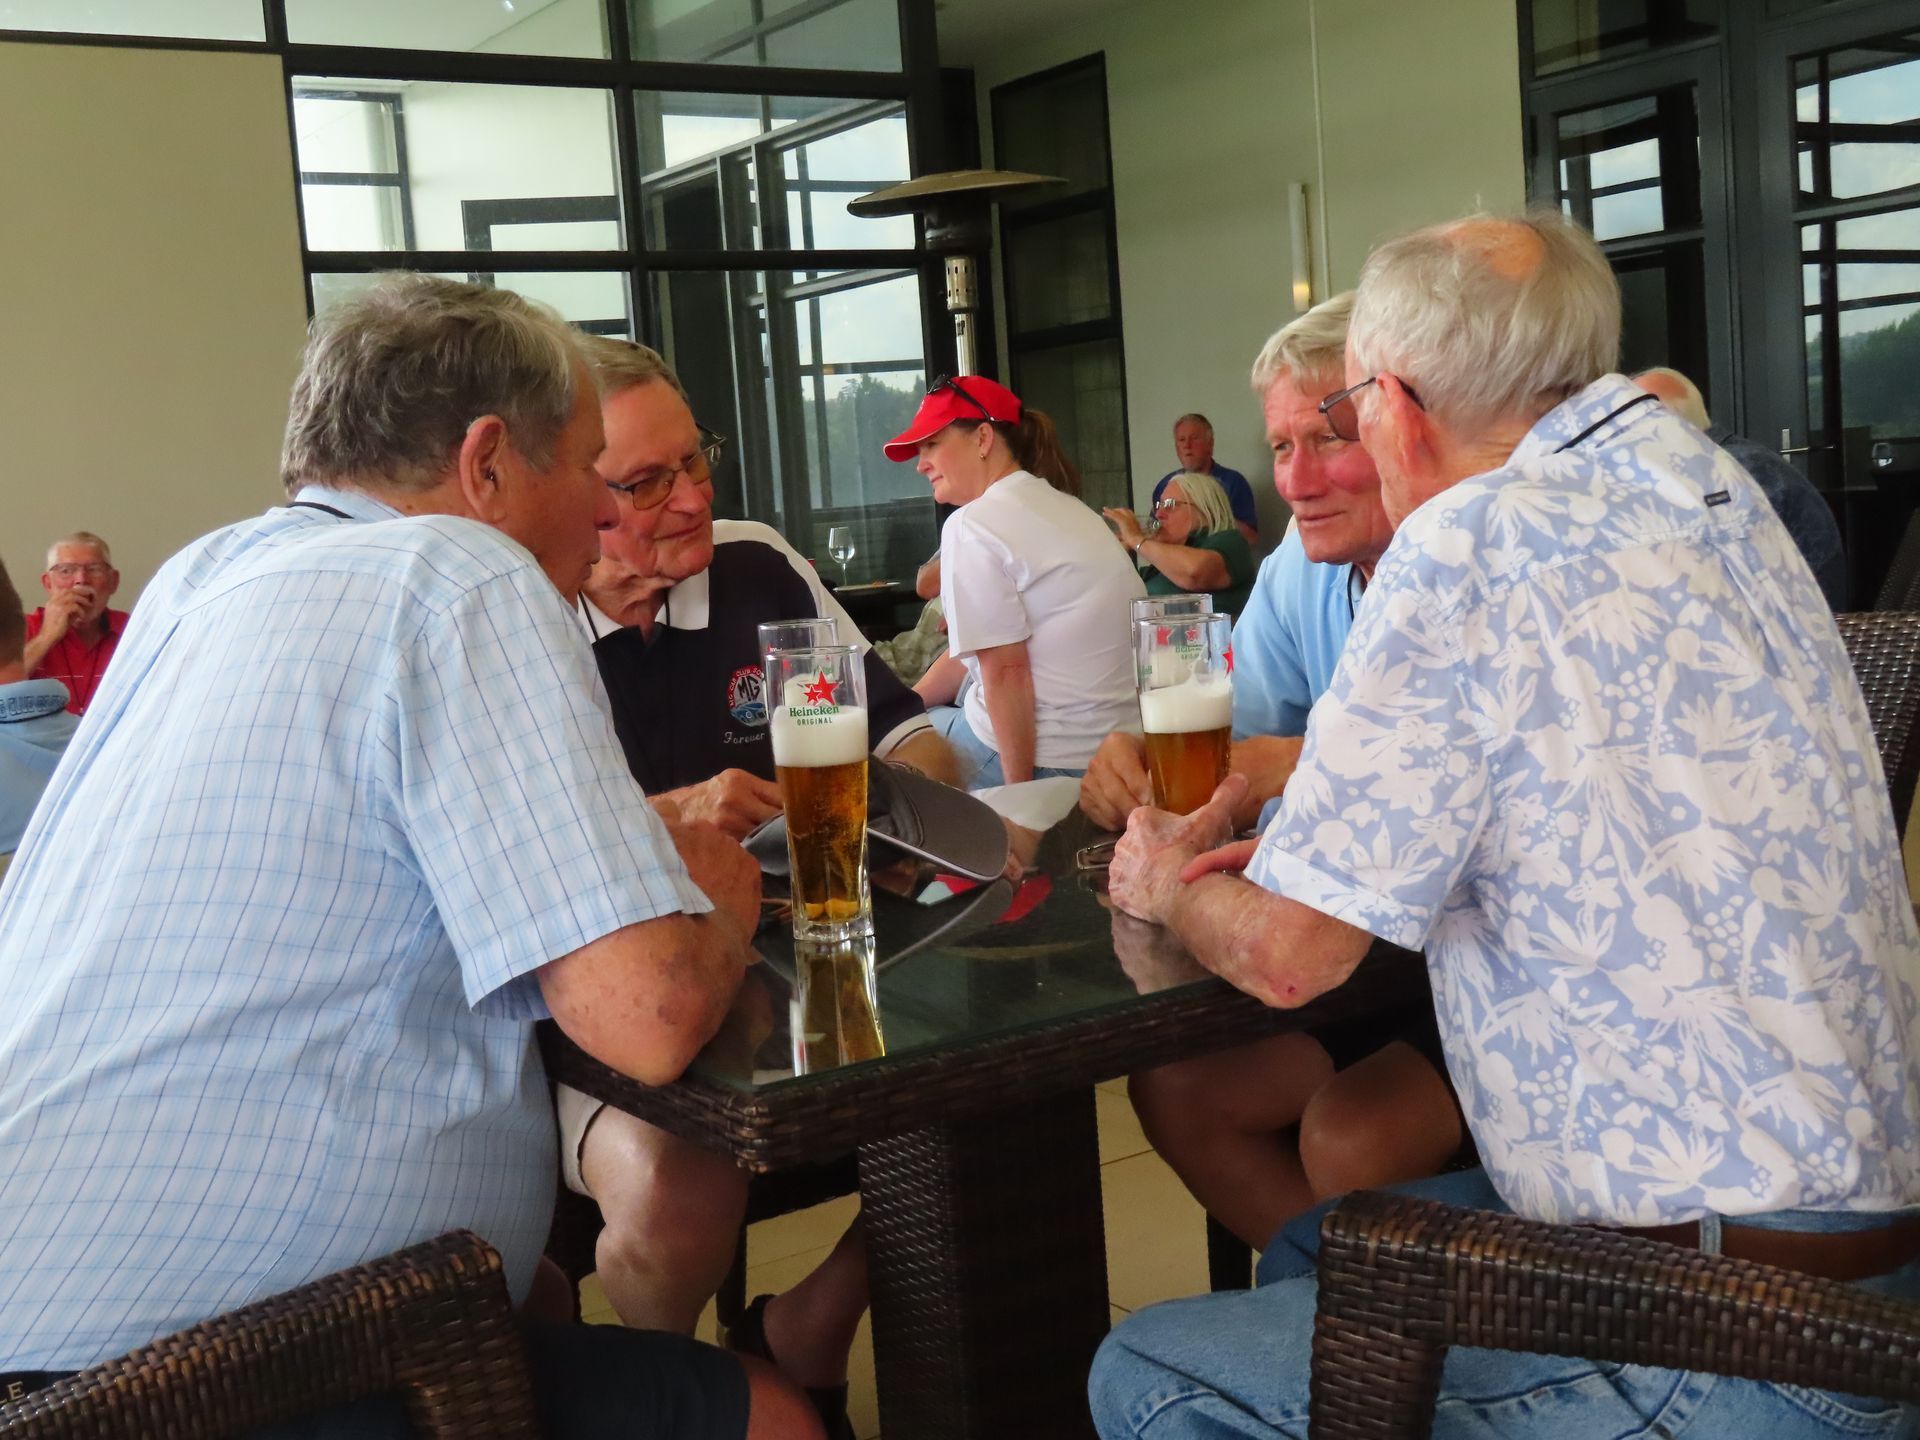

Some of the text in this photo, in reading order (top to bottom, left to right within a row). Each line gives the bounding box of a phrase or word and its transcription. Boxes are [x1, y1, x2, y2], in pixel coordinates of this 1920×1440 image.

[736, 668, 751, 677] CLUB
[737, 675, 760, 701] MG
[789, 705, 839, 717] Heineken
[796, 716, 832, 726] ORIGINAL
